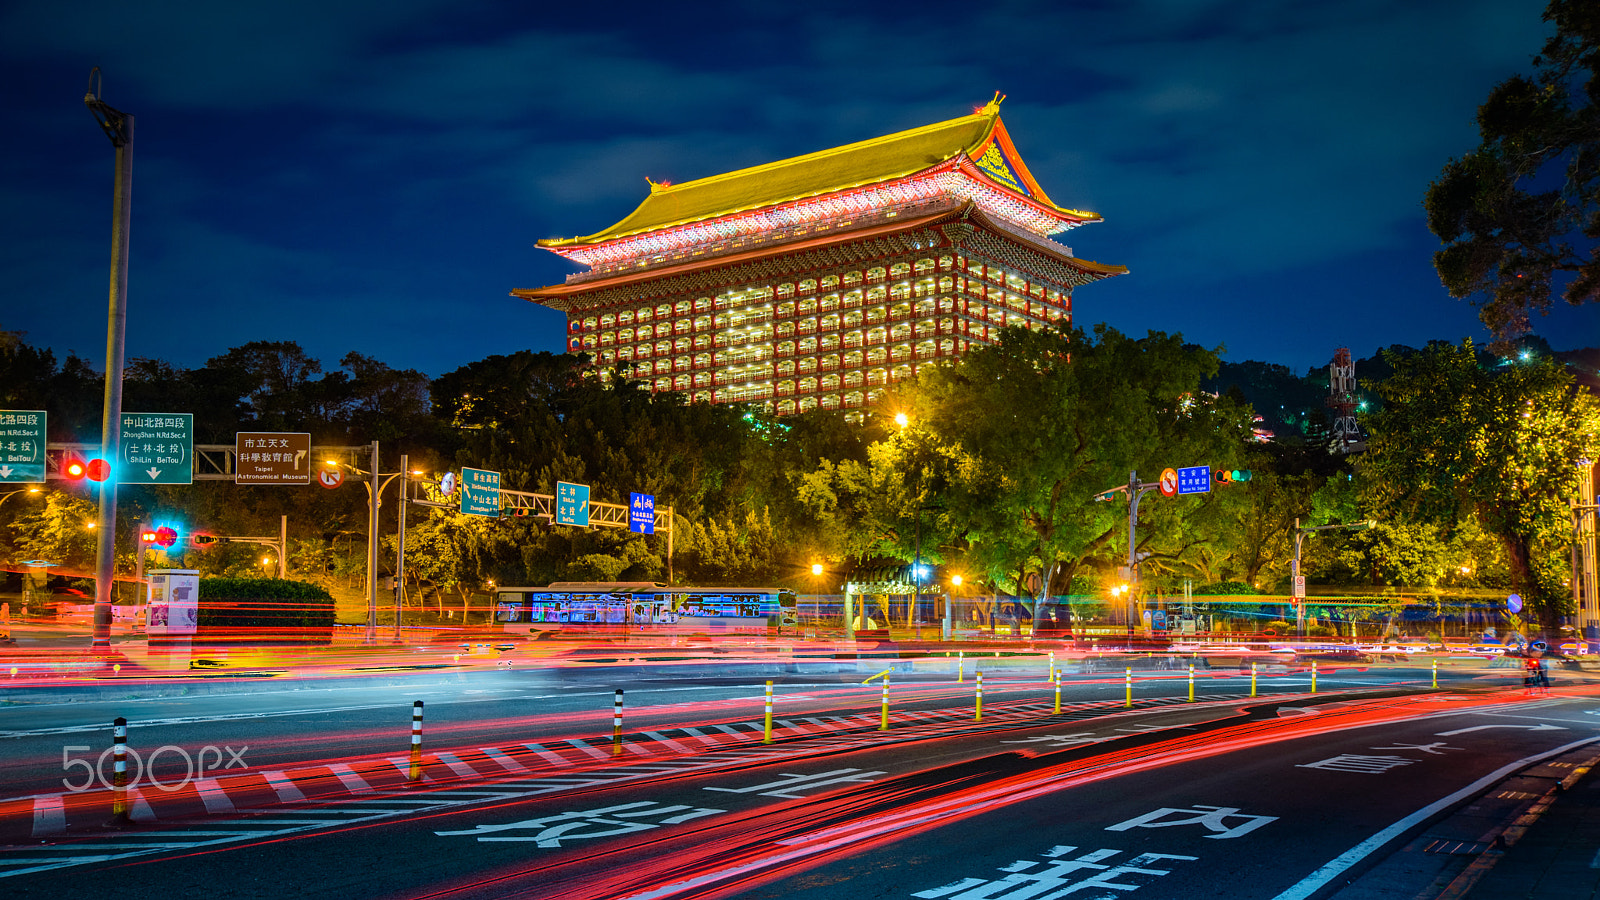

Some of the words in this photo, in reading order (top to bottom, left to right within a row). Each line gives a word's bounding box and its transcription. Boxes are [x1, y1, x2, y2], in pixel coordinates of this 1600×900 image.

[124, 416, 185, 428] 中山北路四段
[123, 431, 155, 439] ZhongShan
[244, 438, 289, 448] 市立天文
[240, 452, 293, 462] 科學教育館
[560, 486, 575, 496] 士林
[473, 494, 498, 505] 中山北路
[560, 506, 575, 516] 北投
